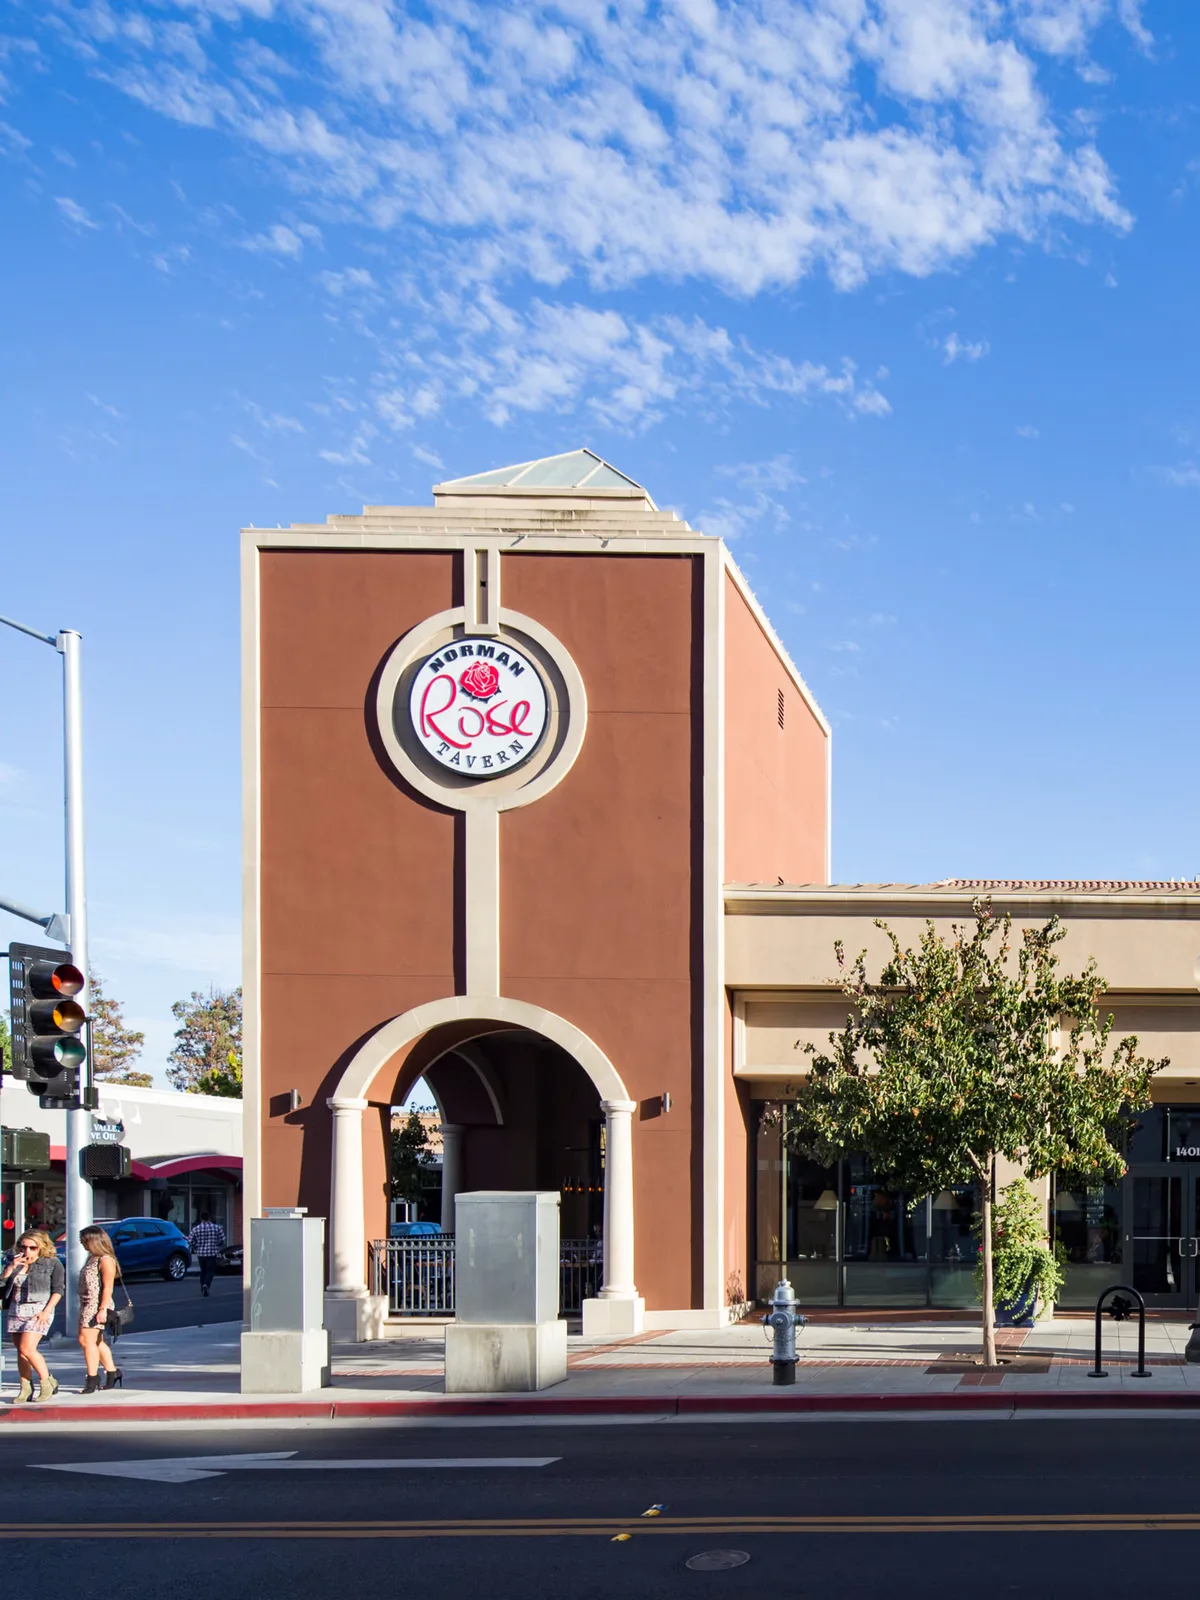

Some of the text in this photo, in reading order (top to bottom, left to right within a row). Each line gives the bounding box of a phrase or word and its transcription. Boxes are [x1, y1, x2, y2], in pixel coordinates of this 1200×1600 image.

[428, 644, 525, 677] NORMAN
[420, 674, 533, 749] Rose
[436, 740, 524, 768] TAVERN
[102, 1131, 118, 1141] OIL
[1175, 1146, 1200, 1157] 1401
